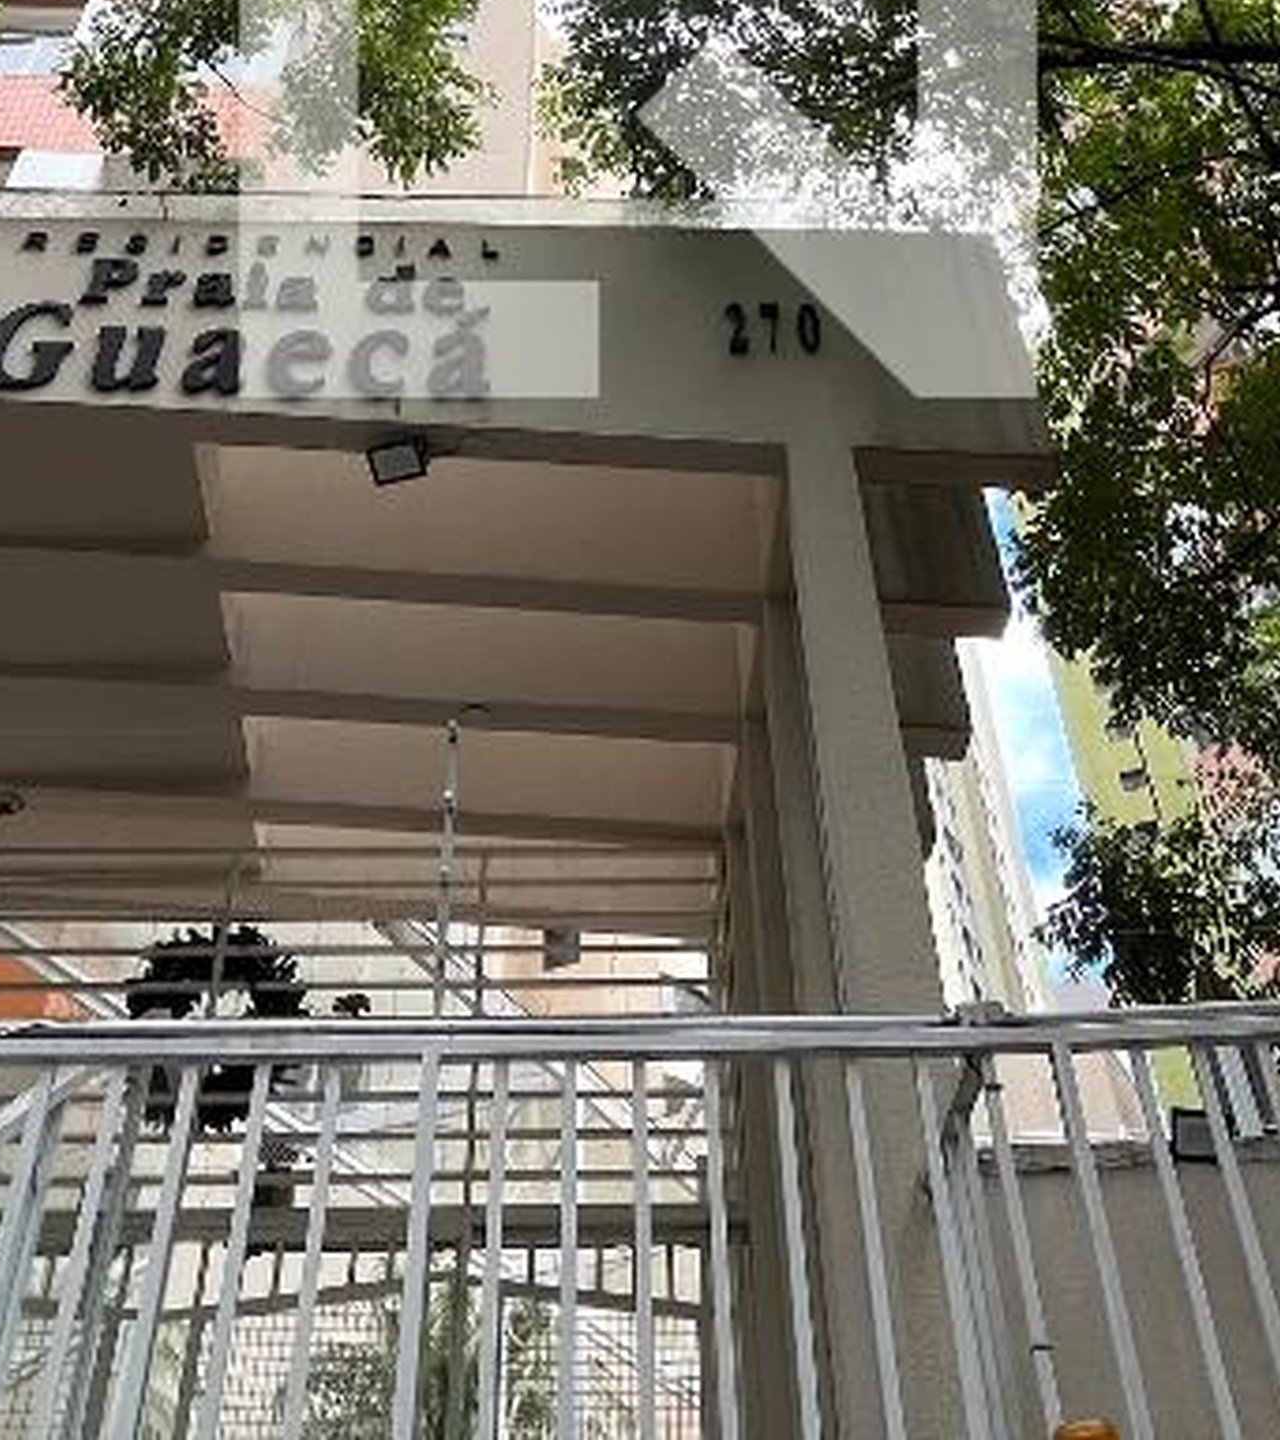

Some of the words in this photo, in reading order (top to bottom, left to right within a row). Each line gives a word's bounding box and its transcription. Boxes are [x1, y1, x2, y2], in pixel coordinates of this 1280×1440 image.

[22, 231, 499, 260] RESIDENCIAL
[77, 258, 318, 312] Praia
[366, 263, 465, 317] de
[724, 302, 821, 356] 270
